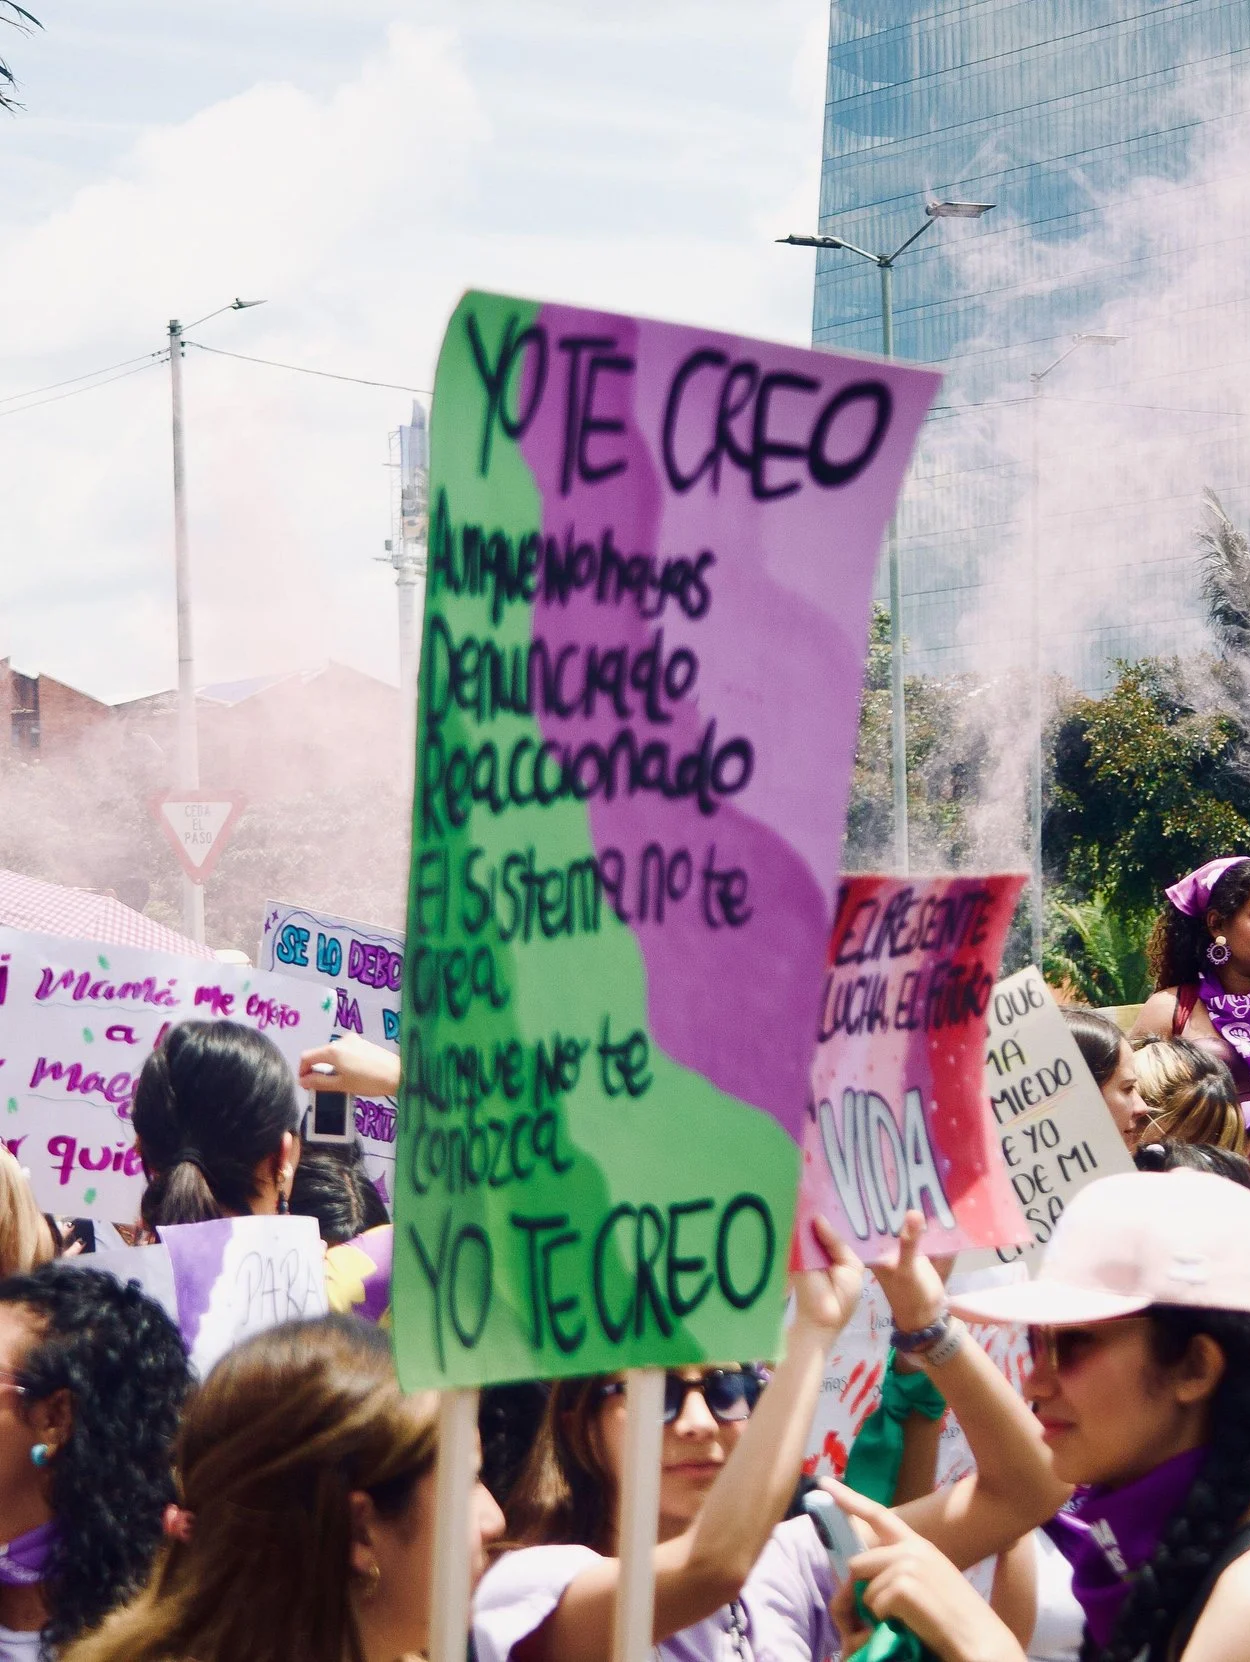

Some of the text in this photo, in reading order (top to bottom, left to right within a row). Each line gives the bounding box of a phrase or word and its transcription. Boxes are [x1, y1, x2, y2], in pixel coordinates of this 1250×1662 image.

[466, 312, 893, 502] YO TE CREO
[184, 804, 211, 817] CEDA
[184, 831, 212, 844] PASO
[192, 818, 204, 830] EL
[704, 843, 755, 930] te
[277, 924, 310, 967] SE
[316, 932, 342, 977] LO
[335, 987, 364, 1034] ÑA
[994, 979, 1045, 1026] QUE
[597, 1013, 654, 1098] te
[990, 1057, 1073, 1125] MIEDO
[819, 1085, 956, 1241] VIDA
[1022, 1118, 1060, 1154] YO
[1012, 1141, 1098, 1205] DE MI
[408, 1192, 776, 1374] YO TE CREO
